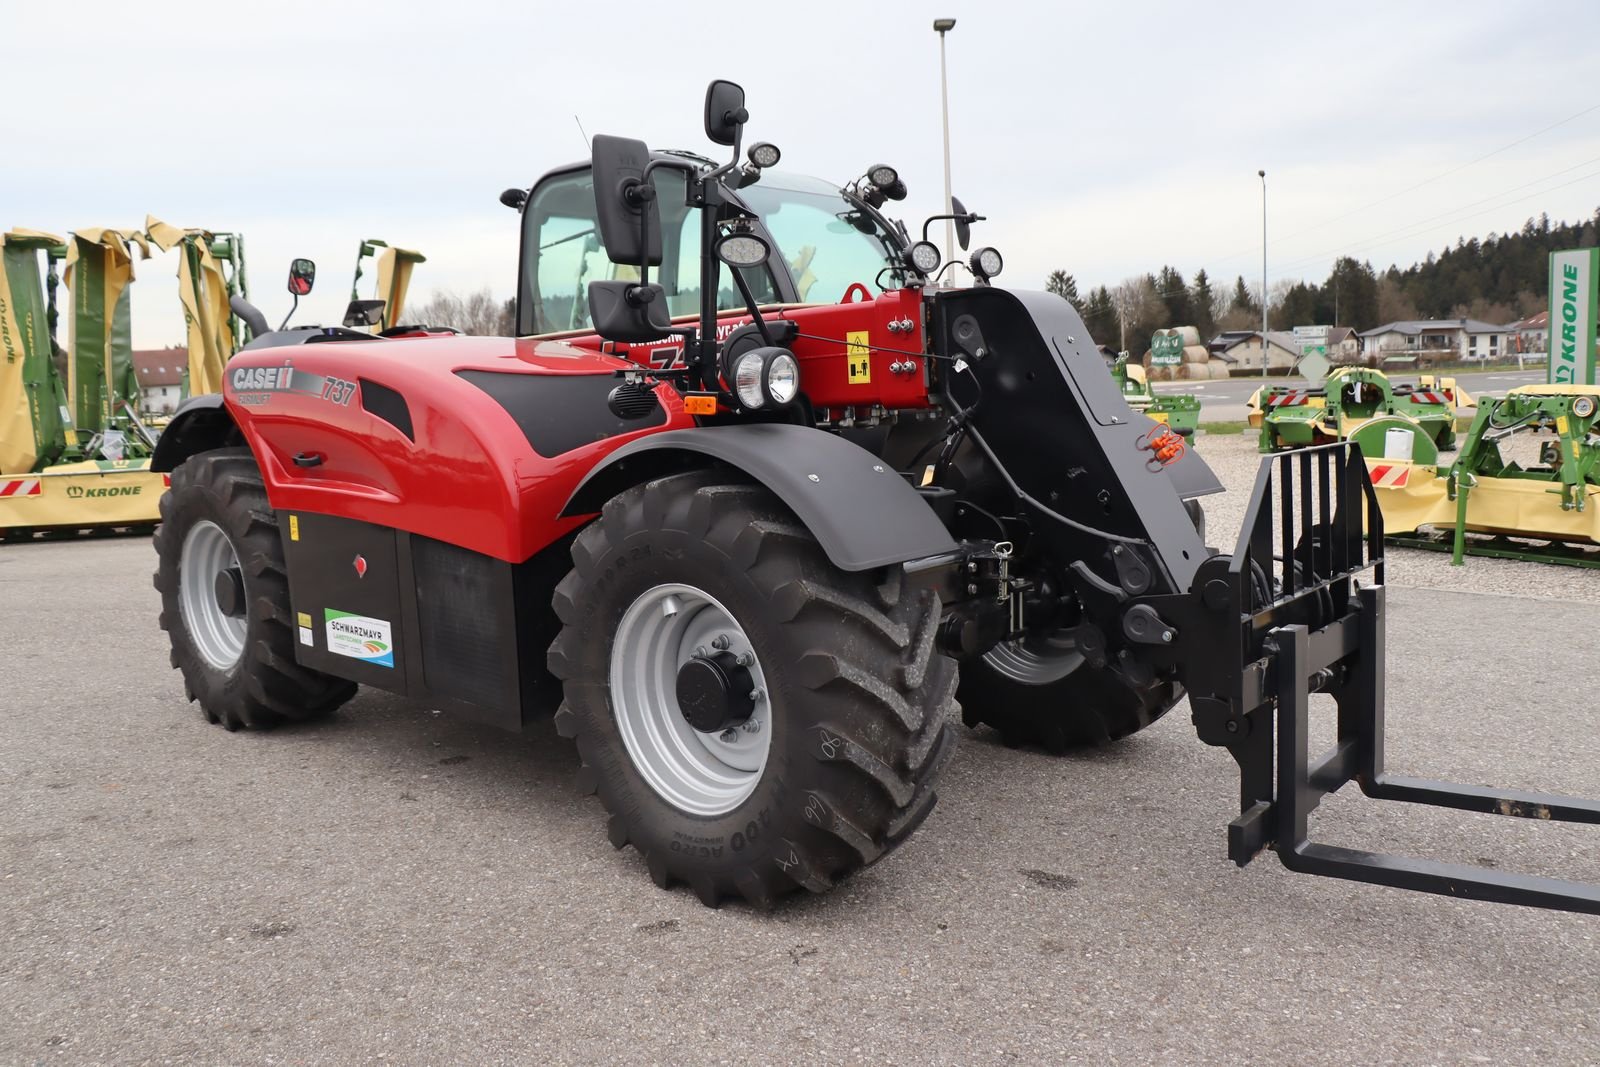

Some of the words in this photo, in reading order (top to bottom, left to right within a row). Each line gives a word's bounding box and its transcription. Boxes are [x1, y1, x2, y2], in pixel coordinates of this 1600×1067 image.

[1561, 264, 1578, 363] KRONE
[233, 368, 277, 389] CASE
[323, 375, 357, 407] 737
[86, 486, 142, 498] KRONE
[331, 621, 382, 640] SCHWARZMAYR
